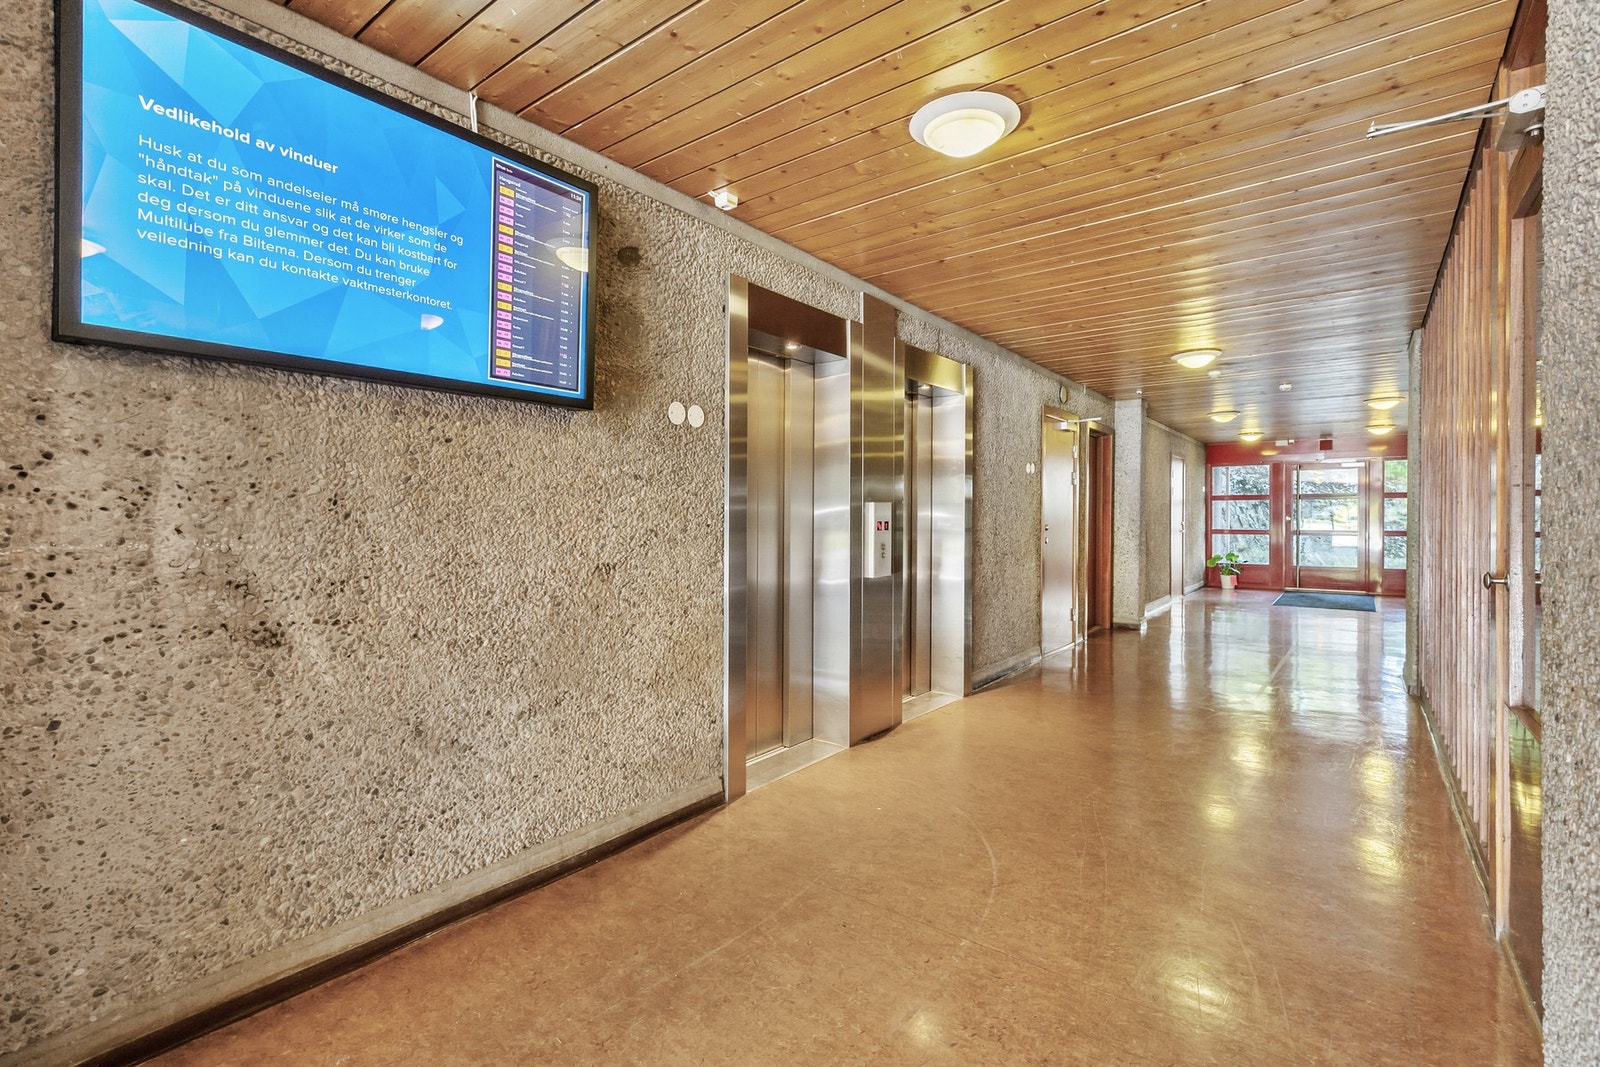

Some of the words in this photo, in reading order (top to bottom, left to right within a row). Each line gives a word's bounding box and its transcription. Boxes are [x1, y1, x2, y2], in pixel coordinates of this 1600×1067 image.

[138, 94, 250, 145] Vedlikehold
[255, 139, 275, 152] av
[279, 146, 338, 174] vinduer
[138, 152, 218, 185] "håndtak"
[223, 180, 242, 193] på
[246, 187, 311, 213] vinduene
[315, 208, 336, 221] slik
[339, 215, 351, 225] at
[355, 219, 371, 231] de
[373, 225, 405, 240] virker
[408, 235, 431, 248] som
[433, 242, 447, 253] de
[138, 173, 176, 192] skal.
[182, 183, 210, 202] Det
[214, 196, 231, 207] er
[235, 200, 258, 215] ditt
[263, 209, 309, 228] ansvar
[312, 223, 329, 236] og
[333, 228, 353, 241] det
[356, 233, 378, 248] kan
[381, 240, 394, 252] bli
[398, 245, 441, 266] kostbart
[443, 258, 458, 269] for
[139, 134, 182, 158] Husk
[187, 152, 202, 164] at
[207, 158, 227, 172] du
[232, 166, 263, 182] som
[267, 177, 337, 205] andelseier
[341, 200, 359, 212] må
[363, 207, 399, 224] smøre
[402, 217, 448, 239] hengsler
[450, 234, 464, 247] og
[137, 191, 171, 211] deg
[176, 202, 236, 226] dersom
[241, 219, 259, 232] du
[264, 226, 324, 248] glemmer
[327, 242, 351, 256] det.
[355, 248, 372, 261] Du
[375, 253, 396, 267] kan
[399, 260, 430, 276] bruke
[137, 208, 214, 237] Multilube
[218, 229, 238, 243] fra
[243, 234, 299, 258] Biltema.
[303, 250, 353, 271] Dersom
[356, 265, 372, 276] du
[375, 269, 416, 287] trenger
[137, 229, 223, 259] veiledning
[228, 248, 254, 264] kan
[259, 257, 277, 269] du
[281, 261, 339, 283] kontakte
[342, 277, 452, 310] vaktmesterkontoret.
